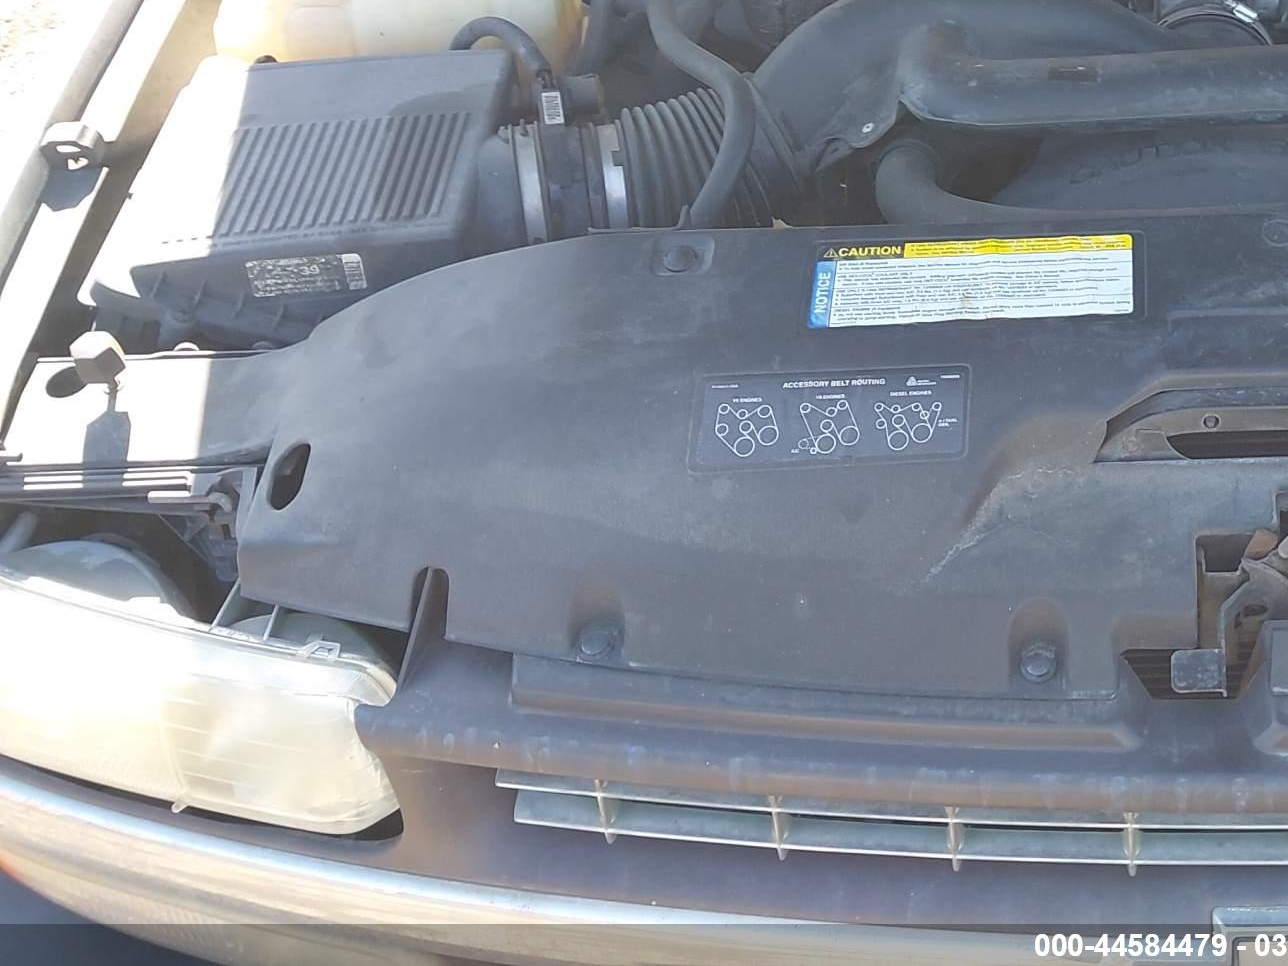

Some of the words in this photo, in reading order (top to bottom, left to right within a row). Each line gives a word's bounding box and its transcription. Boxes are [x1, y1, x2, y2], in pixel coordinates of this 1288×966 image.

[838, 245, 902, 258] CAUTION
[814, 271, 832, 314] NOTICE
[782, 380, 830, 389] ACCESSORY
[830, 379, 851, 388] BELT
[851, 377, 886, 386] ROUTING
